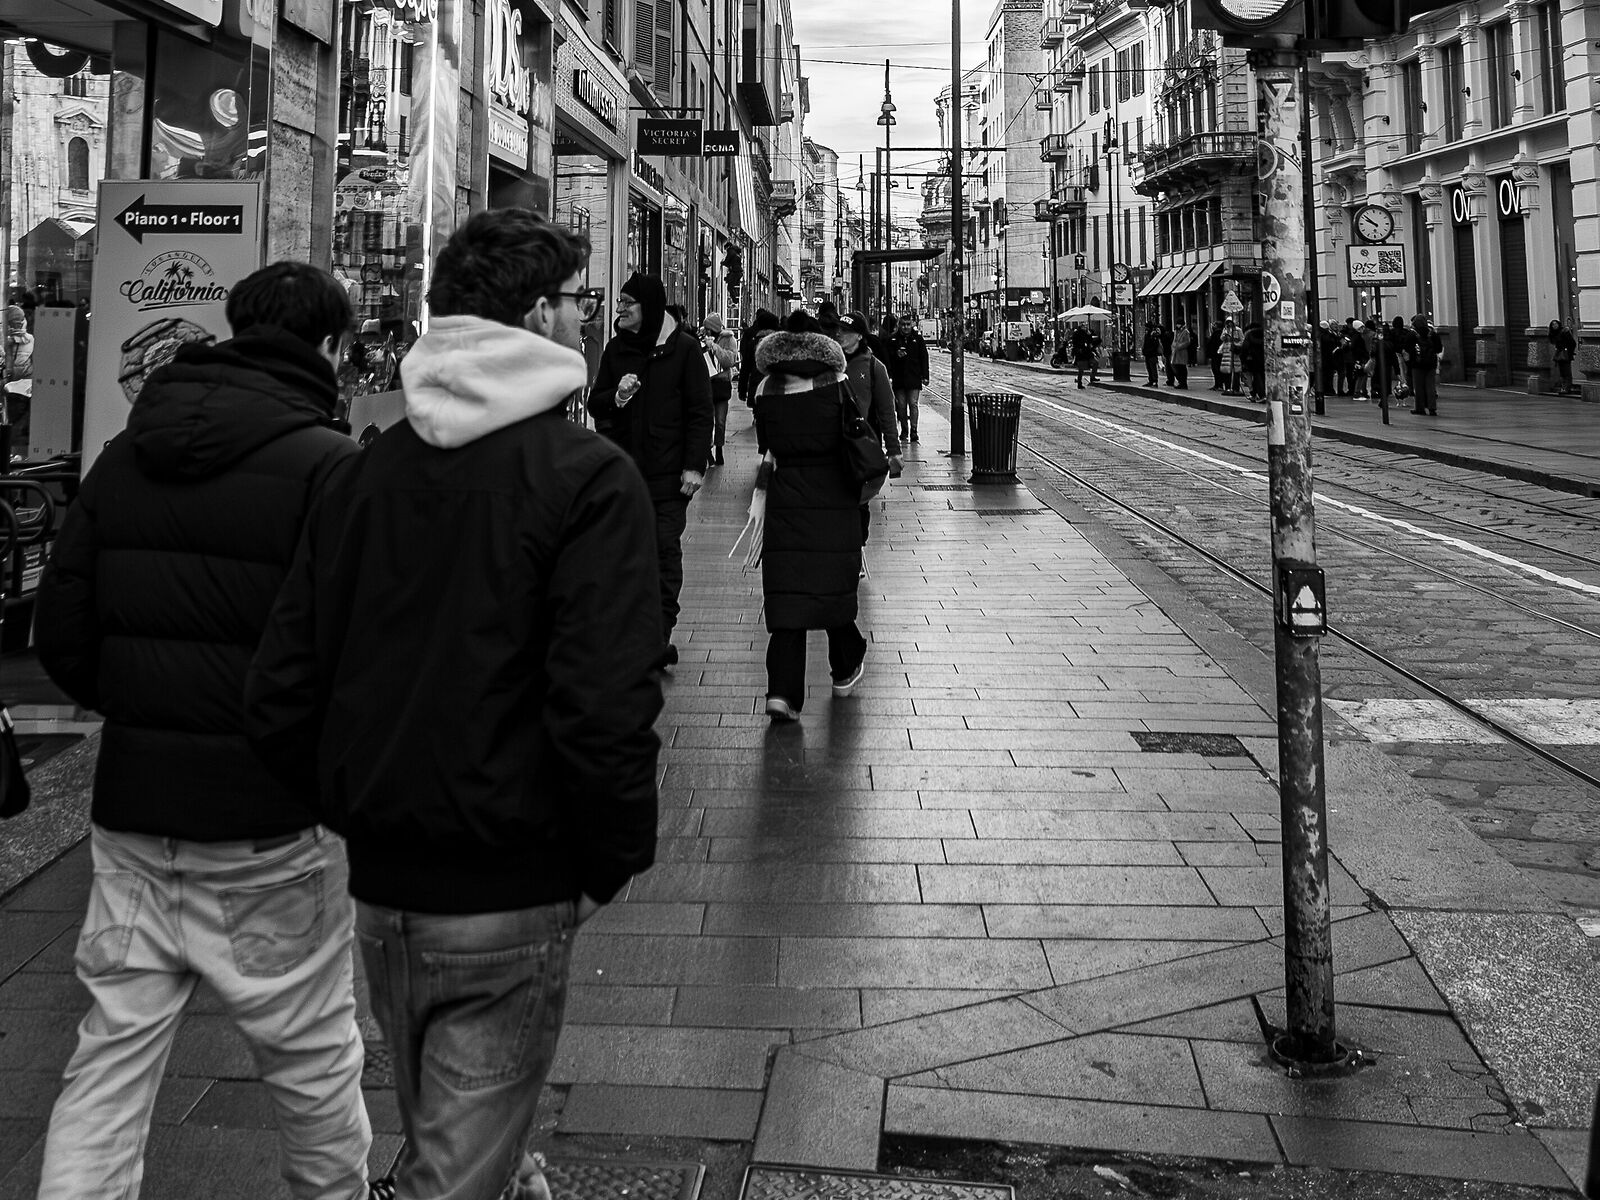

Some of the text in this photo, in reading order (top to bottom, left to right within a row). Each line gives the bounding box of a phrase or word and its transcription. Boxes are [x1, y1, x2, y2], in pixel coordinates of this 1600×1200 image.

[643, 128, 697, 137] VICTORIA'S
[652, 137, 687, 145] SECRET
[125, 211, 240, 226] Piano 1 Floor 1
[120, 279, 229, 304] California
